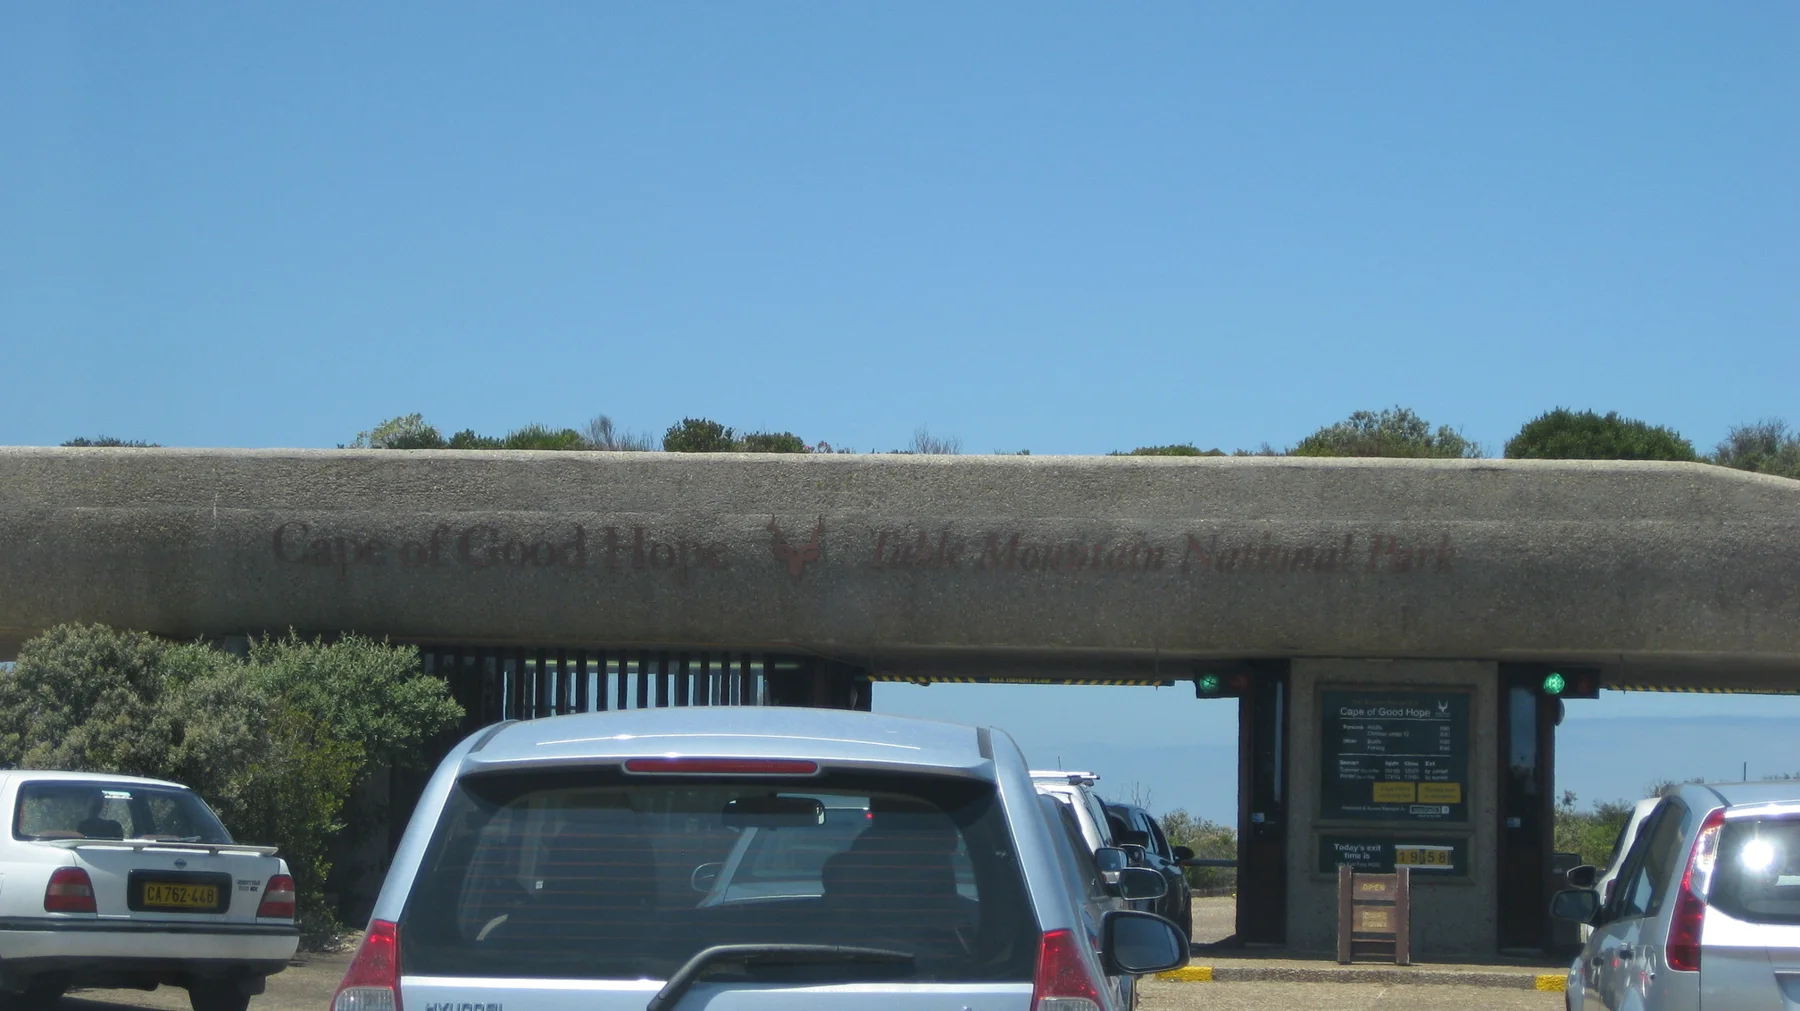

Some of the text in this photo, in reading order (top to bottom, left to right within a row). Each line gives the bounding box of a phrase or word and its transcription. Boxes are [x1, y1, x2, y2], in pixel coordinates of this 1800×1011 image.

[273, 521, 730, 587] Cape of Good Hope
[1340, 706, 1364, 718] Cape
[1367, 707, 1376, 716] of
[1378, 707, 1403, 717] Good
[1406, 708, 1431, 719] Hope
[1334, 844, 1364, 853] Today's
[1344, 852, 1371, 860] time is
[1362, 883, 1386, 891] OPEN
[147, 886, 162, 903] CA
